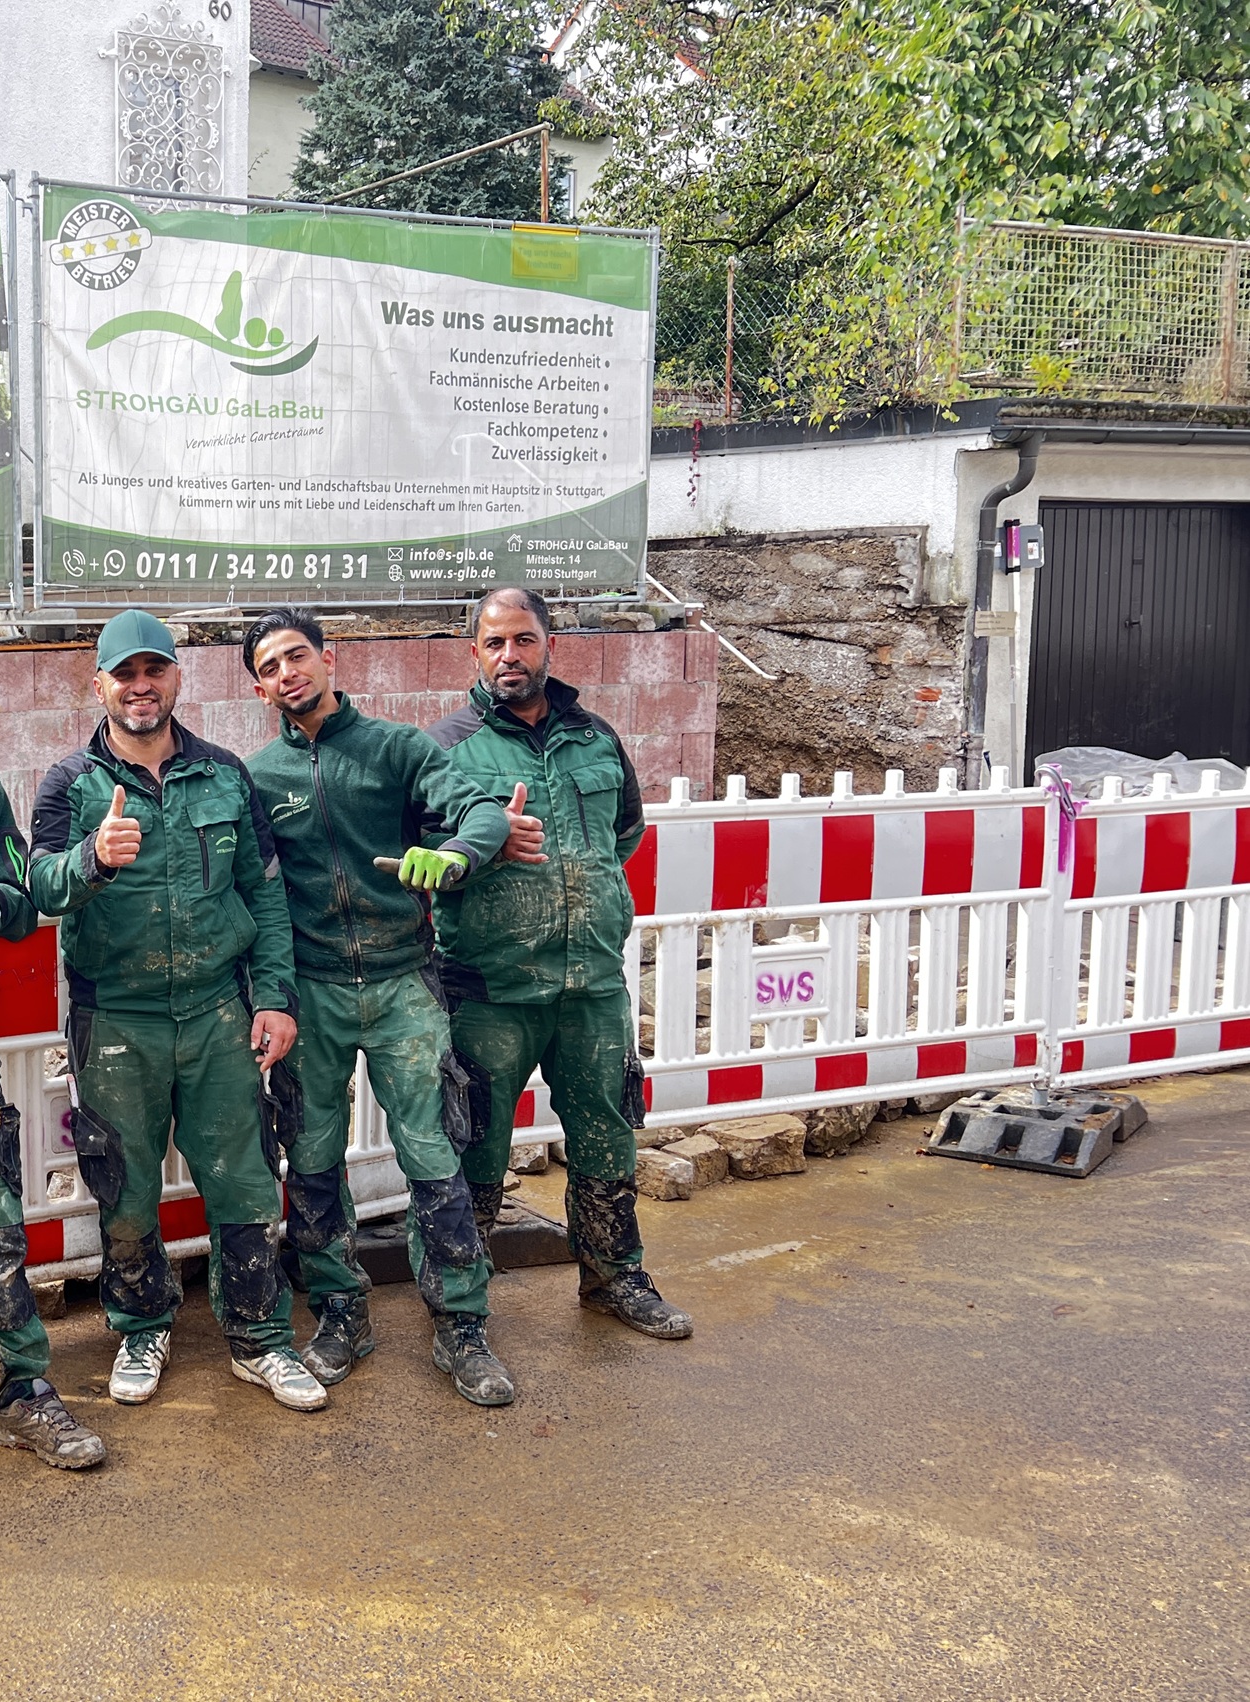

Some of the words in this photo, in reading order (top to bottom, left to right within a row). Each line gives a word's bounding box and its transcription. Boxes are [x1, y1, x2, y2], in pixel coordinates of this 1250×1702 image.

[209, 0, 231, 21] 60
[63, 204, 130, 238] MEISTER
[70, 257, 136, 289] BETRIEB
[381, 301, 434, 327] Was
[442, 310, 485, 331] uns
[493, 314, 614, 338] ausmacht
[450, 348, 601, 369] Kundenzufriedenheit
[429, 371, 533, 390] Fachmännische
[538, 376, 600, 393] Arbeiten
[76, 390, 219, 416] STROHGÄU
[226, 398, 324, 420] GaLaBau
[453, 397, 530, 414] Kostenlose
[534, 400, 600, 419] Beratung
[185, 433, 247, 450] Verwirklicht
[250, 425, 325, 444] Gartenträume
[487, 422, 599, 441] Fachkompetenz
[491, 446, 598, 465] Zuverlässigkeit
[78, 472, 98, 486] Als
[101, 474, 144, 490] Junges
[148, 475, 173, 489] und
[177, 476, 228, 490] kreatives
[231, 478, 275, 491] Garten-
[279, 478, 301, 491] und
[305, 479, 391, 494] Landschaftsbau
[394, 482, 470, 495] Unternehmen
[473, 484, 489, 496] mit
[492, 484, 541, 498] Hauptsitz
[544, 485, 553, 496] in
[556, 485, 606, 499] Stuttgart,
[179, 496, 233, 509] kümmern
[236, 498, 256, 509] wir
[259, 499, 281, 510] uns
[284, 498, 303, 510] mit
[306, 498, 335, 510] Liebe
[338, 499, 360, 511] und
[363, 499, 436, 512] Leidenschaft
[438, 502, 455, 512] um
[458, 500, 483, 512] Ihren
[485, 501, 525, 514] Garten.
[527, 538, 583, 550] STROHGÄU
[586, 540, 628, 550] GaLaBau
[136, 552, 197, 579] 0711
[208, 553, 218, 579] /
[226, 553, 256, 579] 34
[265, 553, 294, 579] 20
[303, 553, 331, 579] 81
[341, 553, 369, 579] 31
[409, 548, 494, 564] info@s-glb.de
[526, 555, 566, 565] Mittelstr.
[569, 555, 581, 565] 14
[409, 566, 497, 582] www.s-glb.de
[525, 568, 553, 579] 70180
[554, 568, 597, 580] Stuttgart
[756, 971, 815, 1004] SVS
